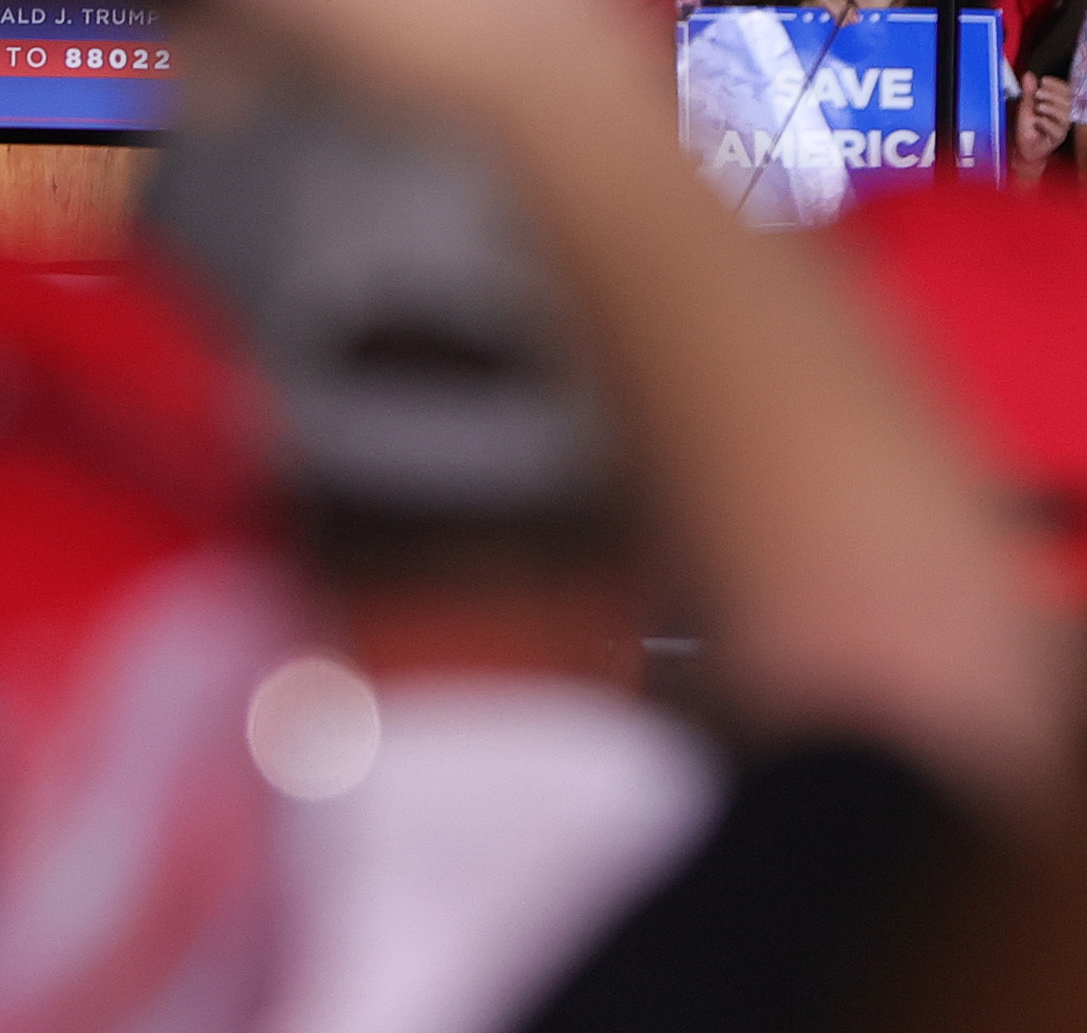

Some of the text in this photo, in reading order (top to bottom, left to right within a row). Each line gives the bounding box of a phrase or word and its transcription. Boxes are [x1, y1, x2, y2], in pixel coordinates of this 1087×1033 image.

[55, 8, 72, 25] J.
[6, 47, 47, 68] TO
[65, 48, 170, 70] 88022
[774, 68, 913, 111] SAVE
